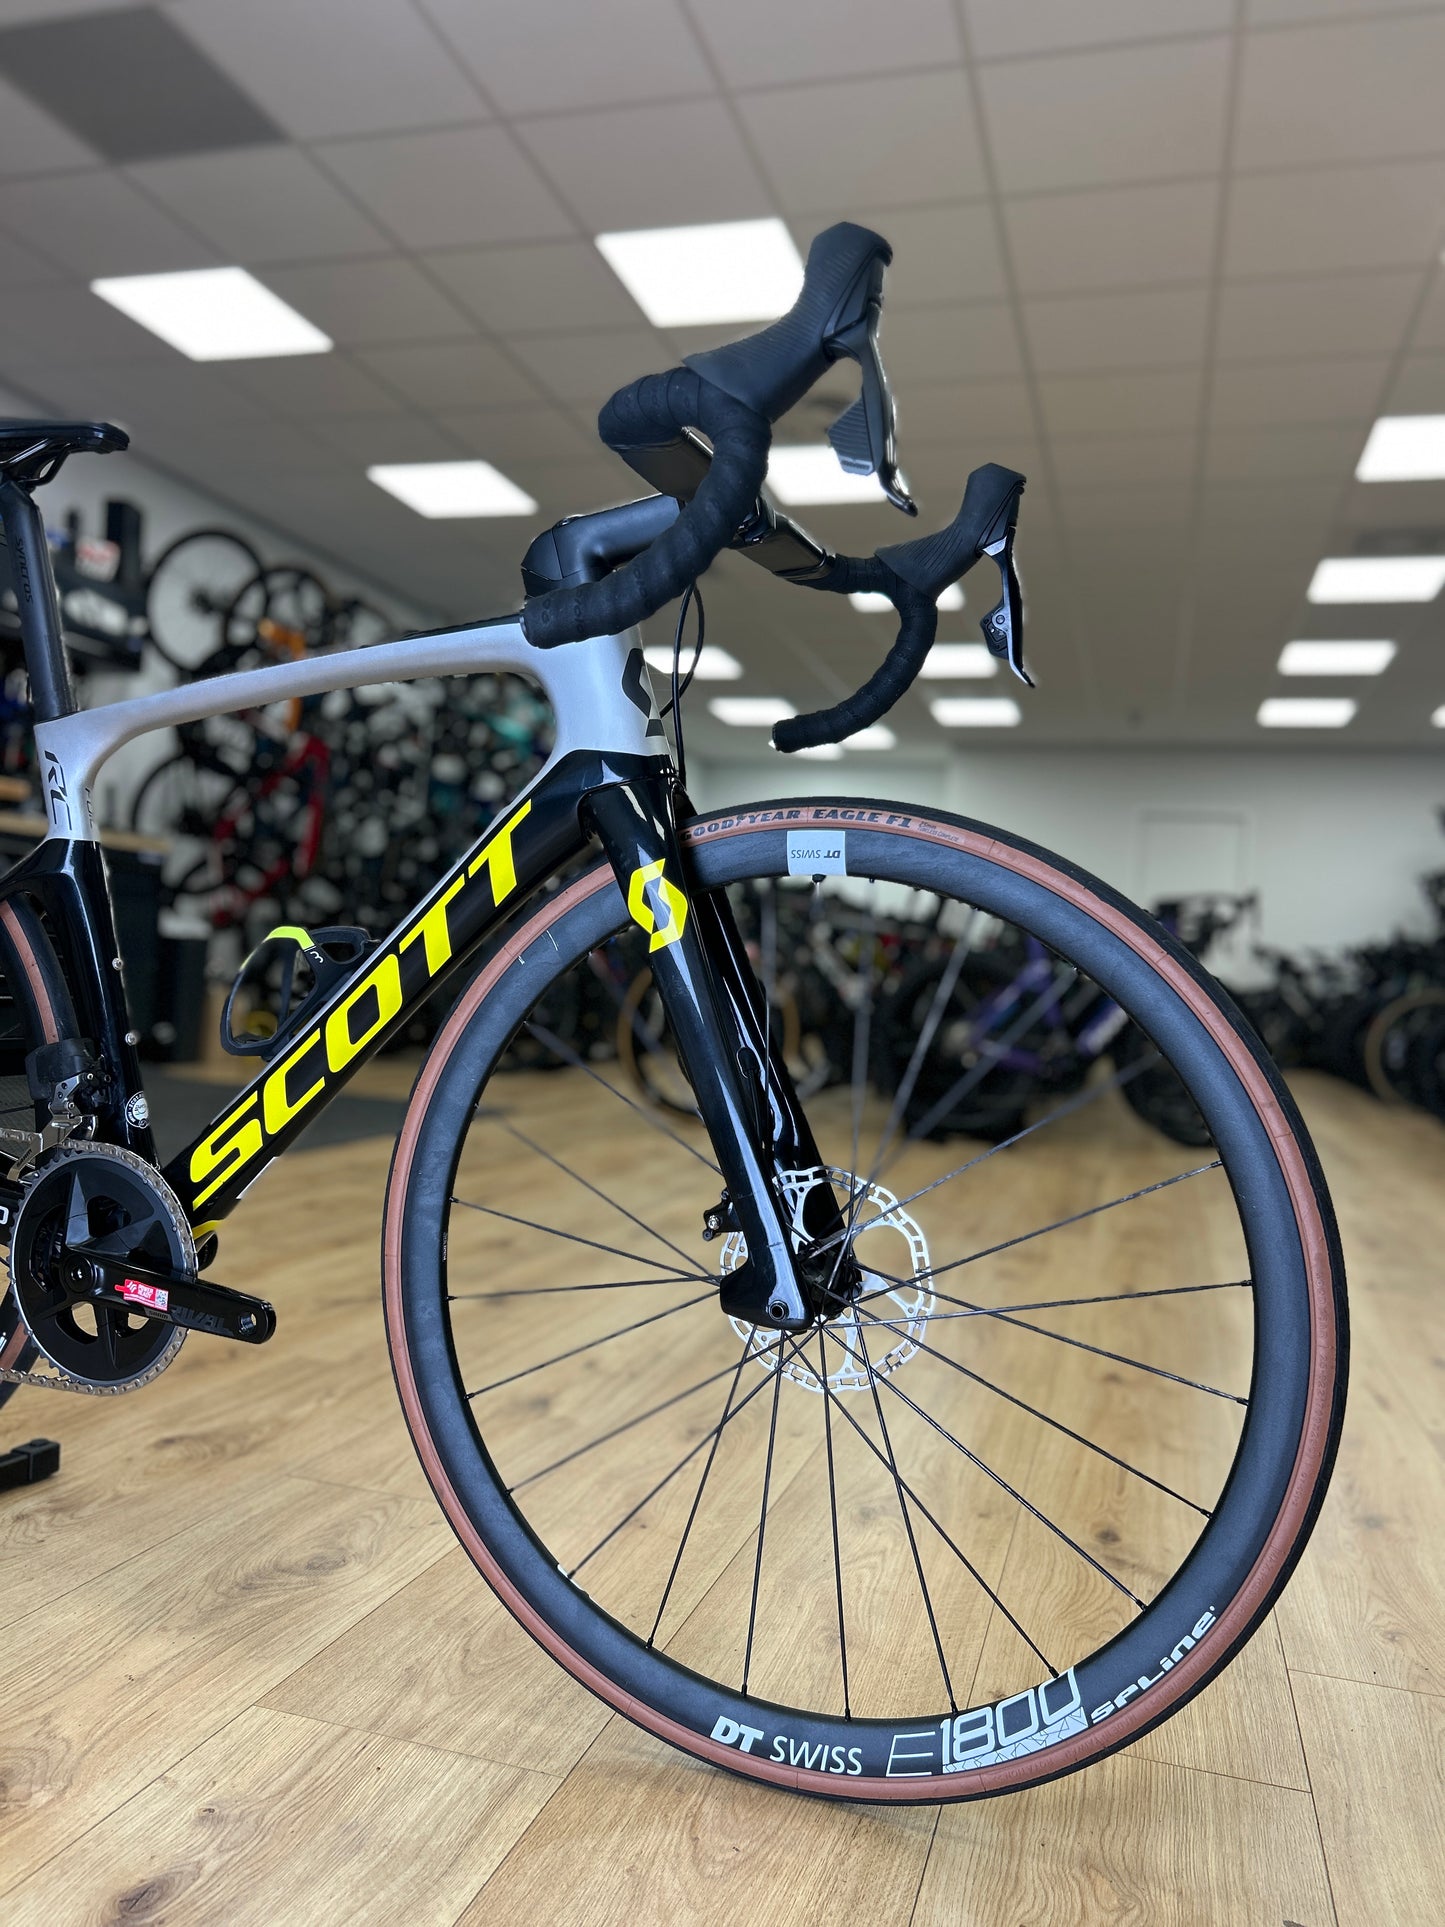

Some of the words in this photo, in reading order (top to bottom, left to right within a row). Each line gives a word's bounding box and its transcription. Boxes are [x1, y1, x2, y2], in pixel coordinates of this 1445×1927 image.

[812, 808, 880, 824] EAGLE
[886, 814, 913, 829] F1
[790, 848, 822, 859] SWISS
[824, 849, 841, 859] DT
[190, 799, 532, 1211] SCOTT
[709, 1715, 764, 1753] DT
[769, 1735, 862, 1776] SWISS
